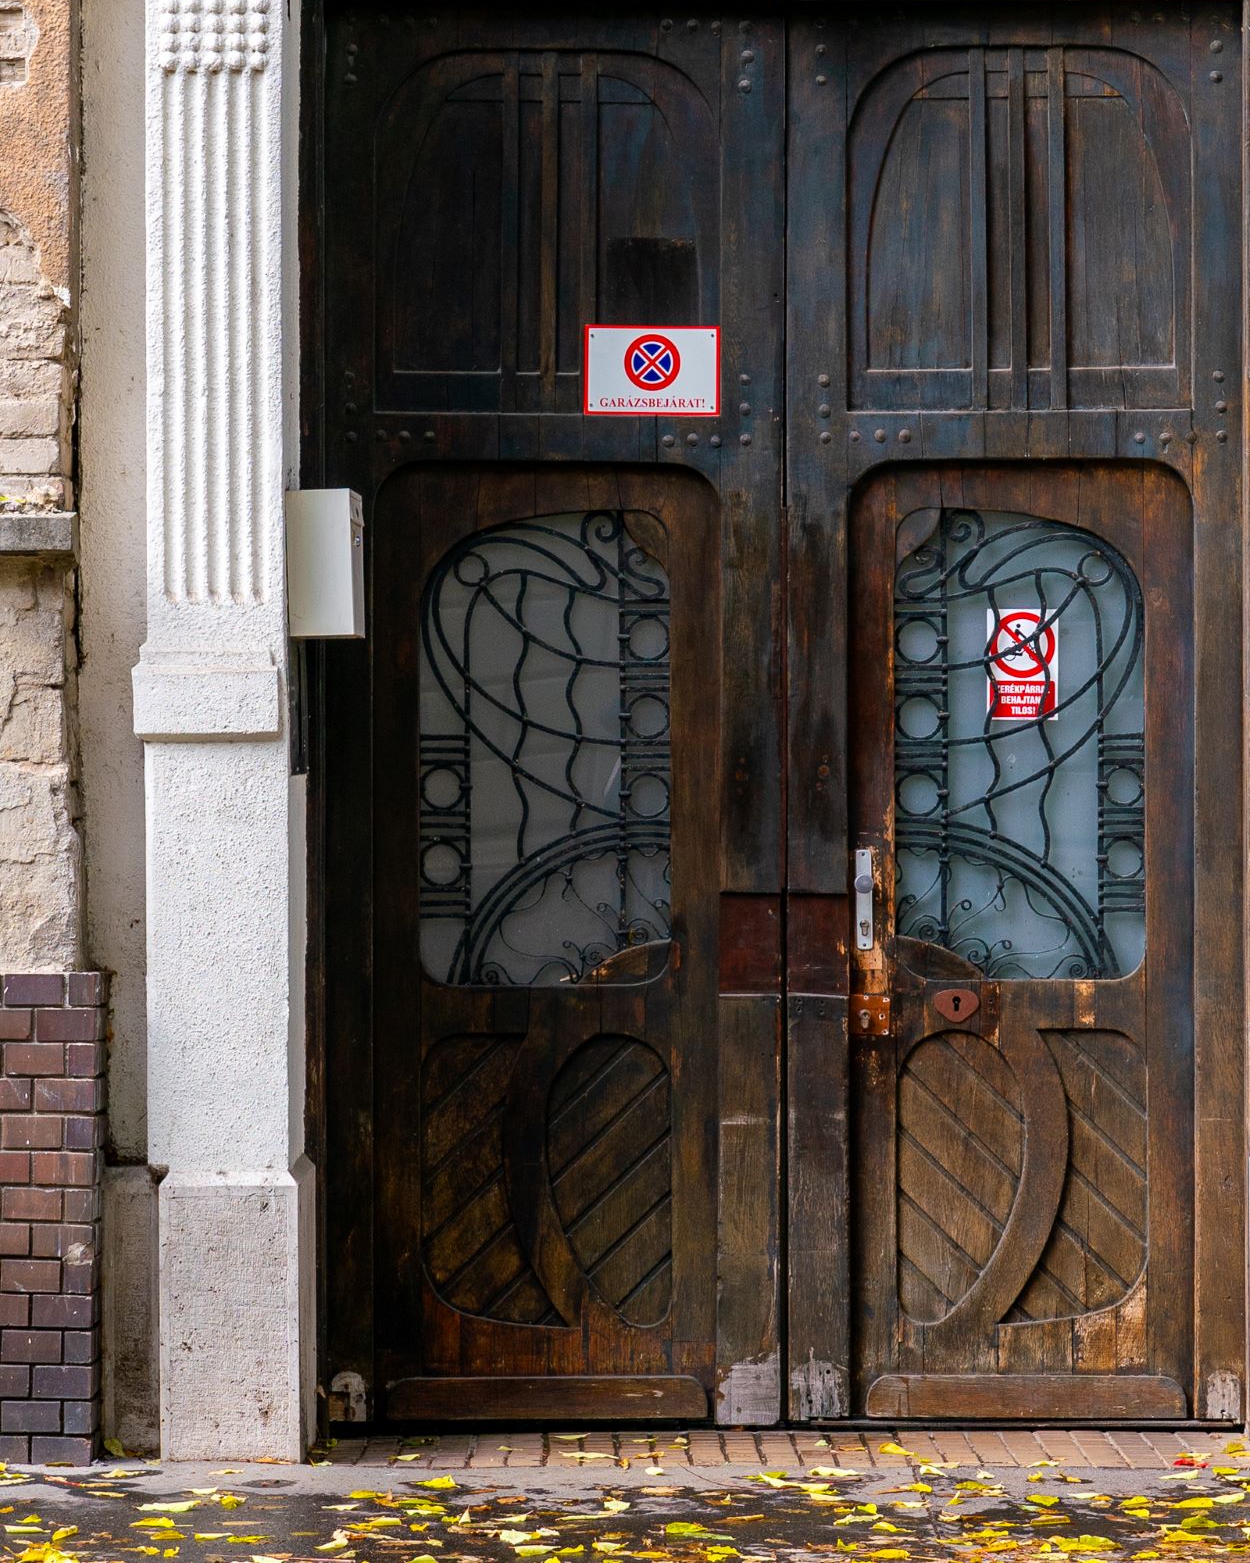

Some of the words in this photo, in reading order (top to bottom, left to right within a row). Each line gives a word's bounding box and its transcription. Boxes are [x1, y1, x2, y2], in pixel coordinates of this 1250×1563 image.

[599, 395, 706, 408] GARÁZSBEJÁRAT!
[997, 683, 1051, 694] ERÉKPÁRRA
[1001, 695, 1042, 705] BEHAJTAN
[1011, 706, 1036, 715] TILOS!
